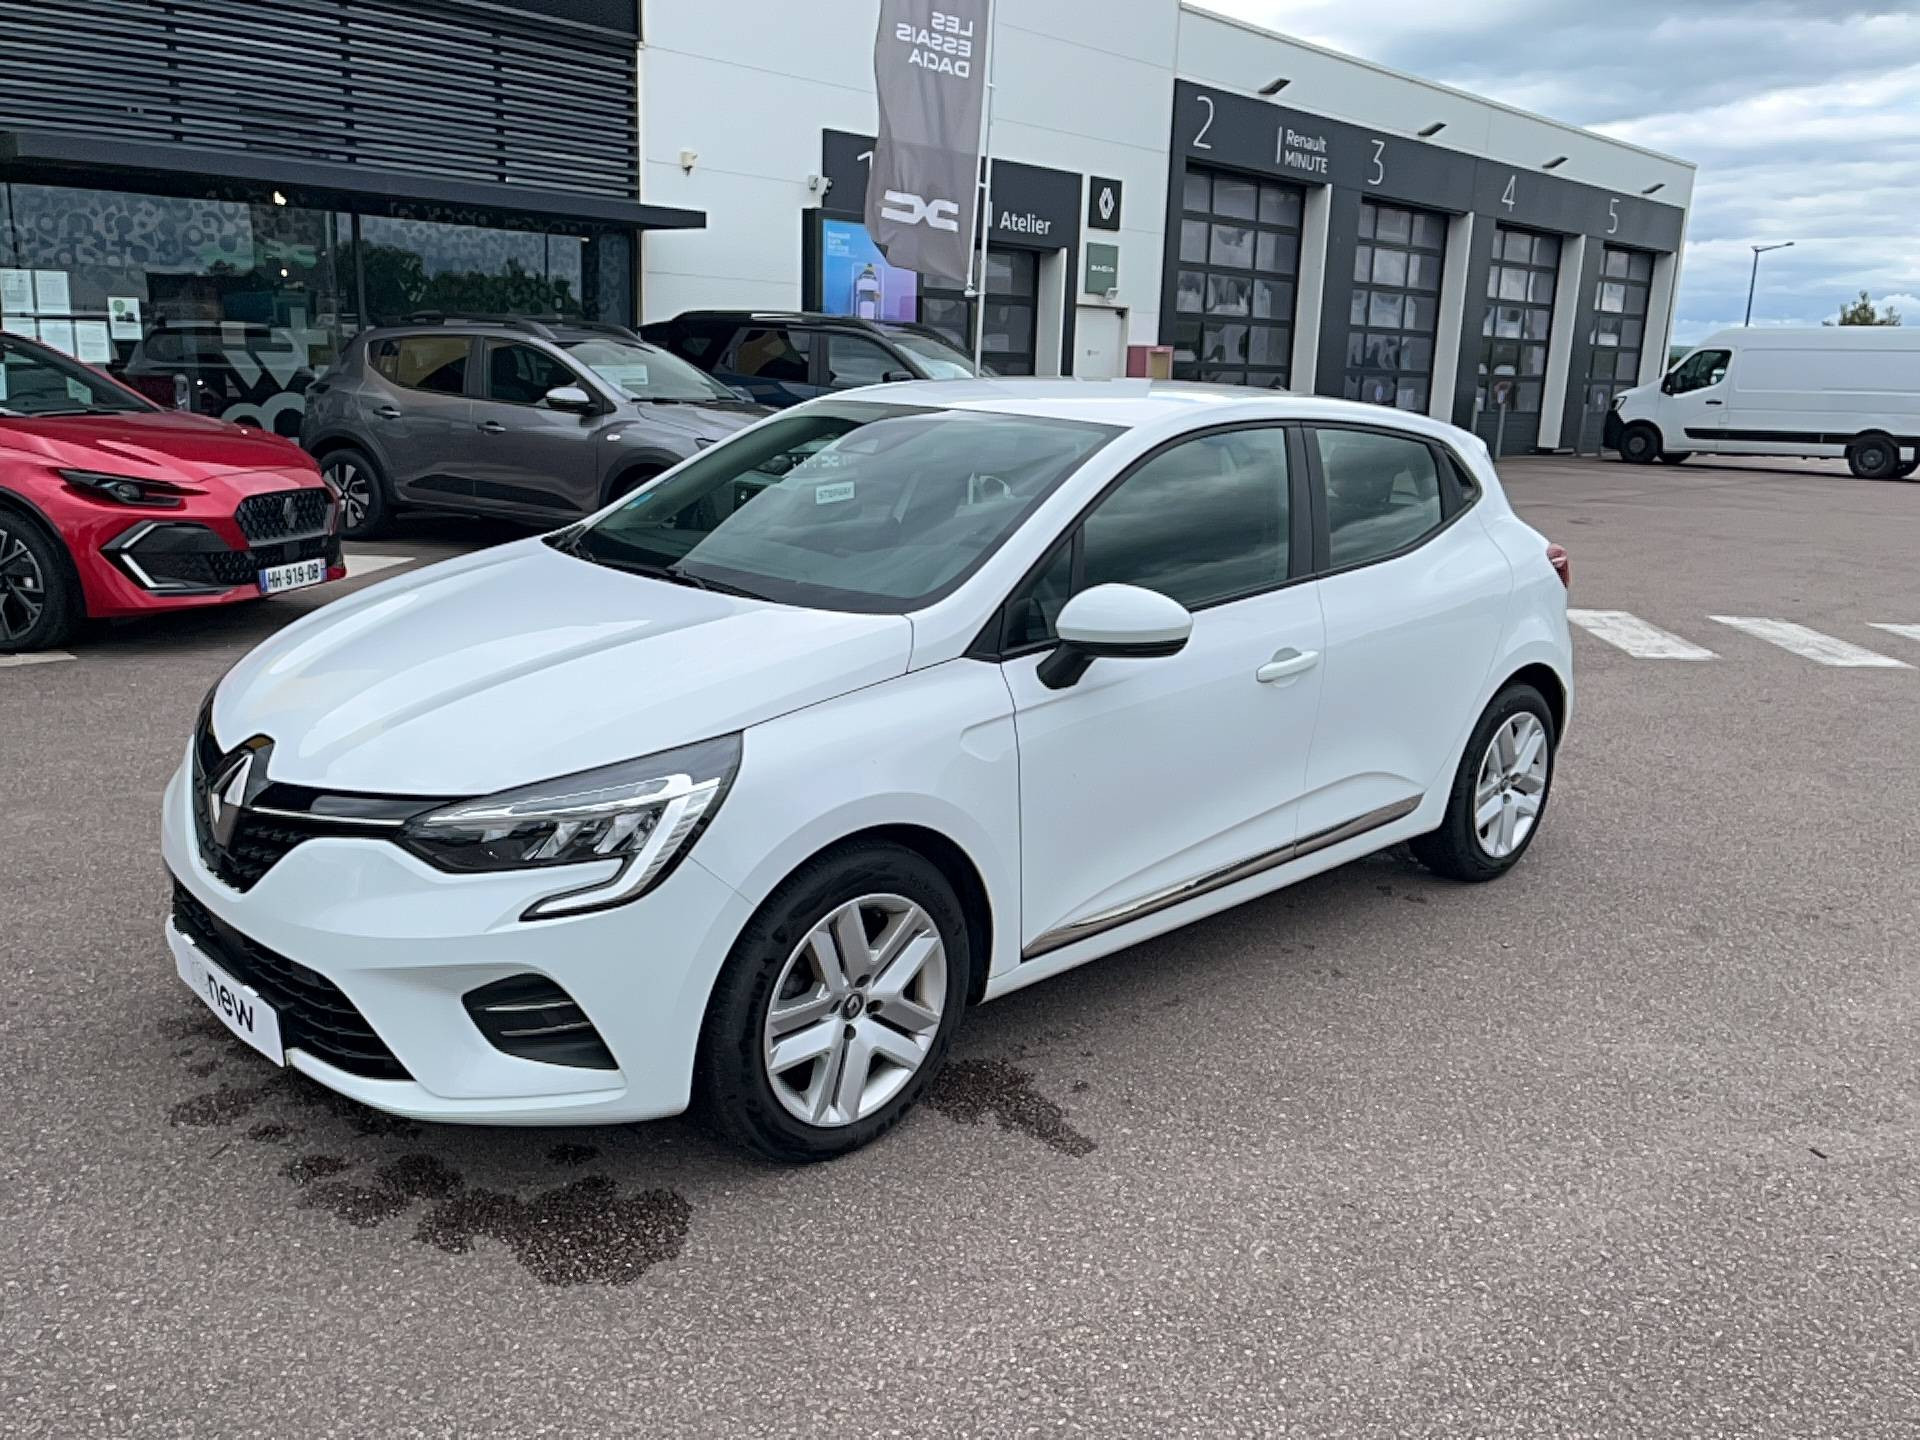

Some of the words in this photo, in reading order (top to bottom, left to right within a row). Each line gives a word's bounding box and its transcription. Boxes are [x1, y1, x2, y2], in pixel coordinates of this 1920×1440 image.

[1193, 95, 1214, 149] 2
[1285, 129, 1327, 153] Renault
[1284, 149, 1328, 175] MINUTE
[1367, 139, 1385, 185] 3
[1501, 174, 1517, 212] 4
[999, 210, 1051, 235] Atelier
[1607, 198, 1620, 234] 5
